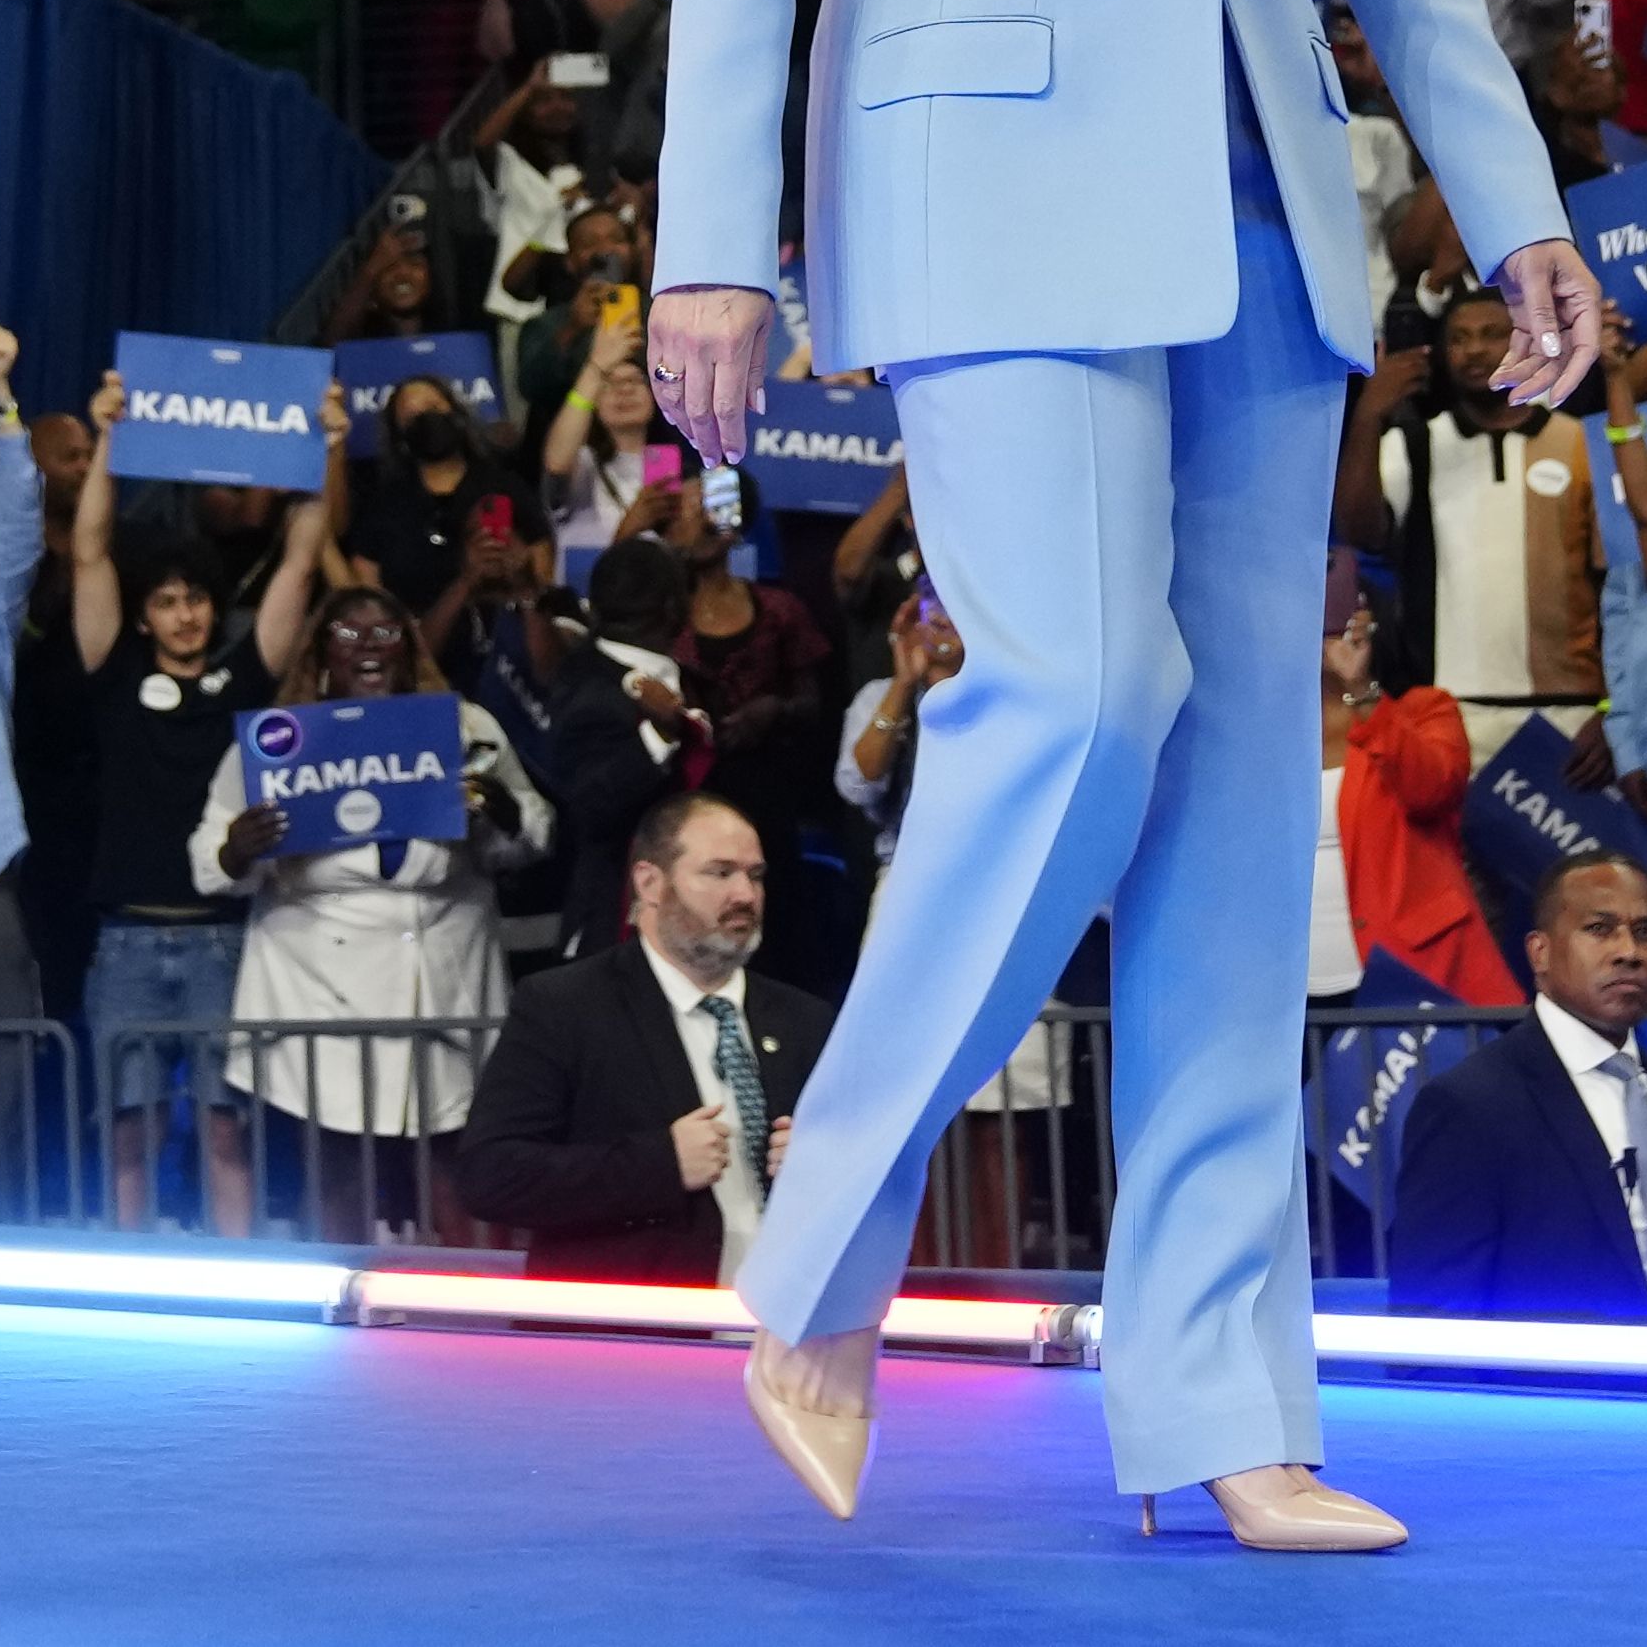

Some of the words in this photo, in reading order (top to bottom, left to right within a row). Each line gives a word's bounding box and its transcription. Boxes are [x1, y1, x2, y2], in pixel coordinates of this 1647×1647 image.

[129, 388, 310, 436] KAMALA
[754, 427, 904, 467] KAMALA
[259, 750, 445, 800] KAMALA
[1493, 768, 1602, 856] KAMA
